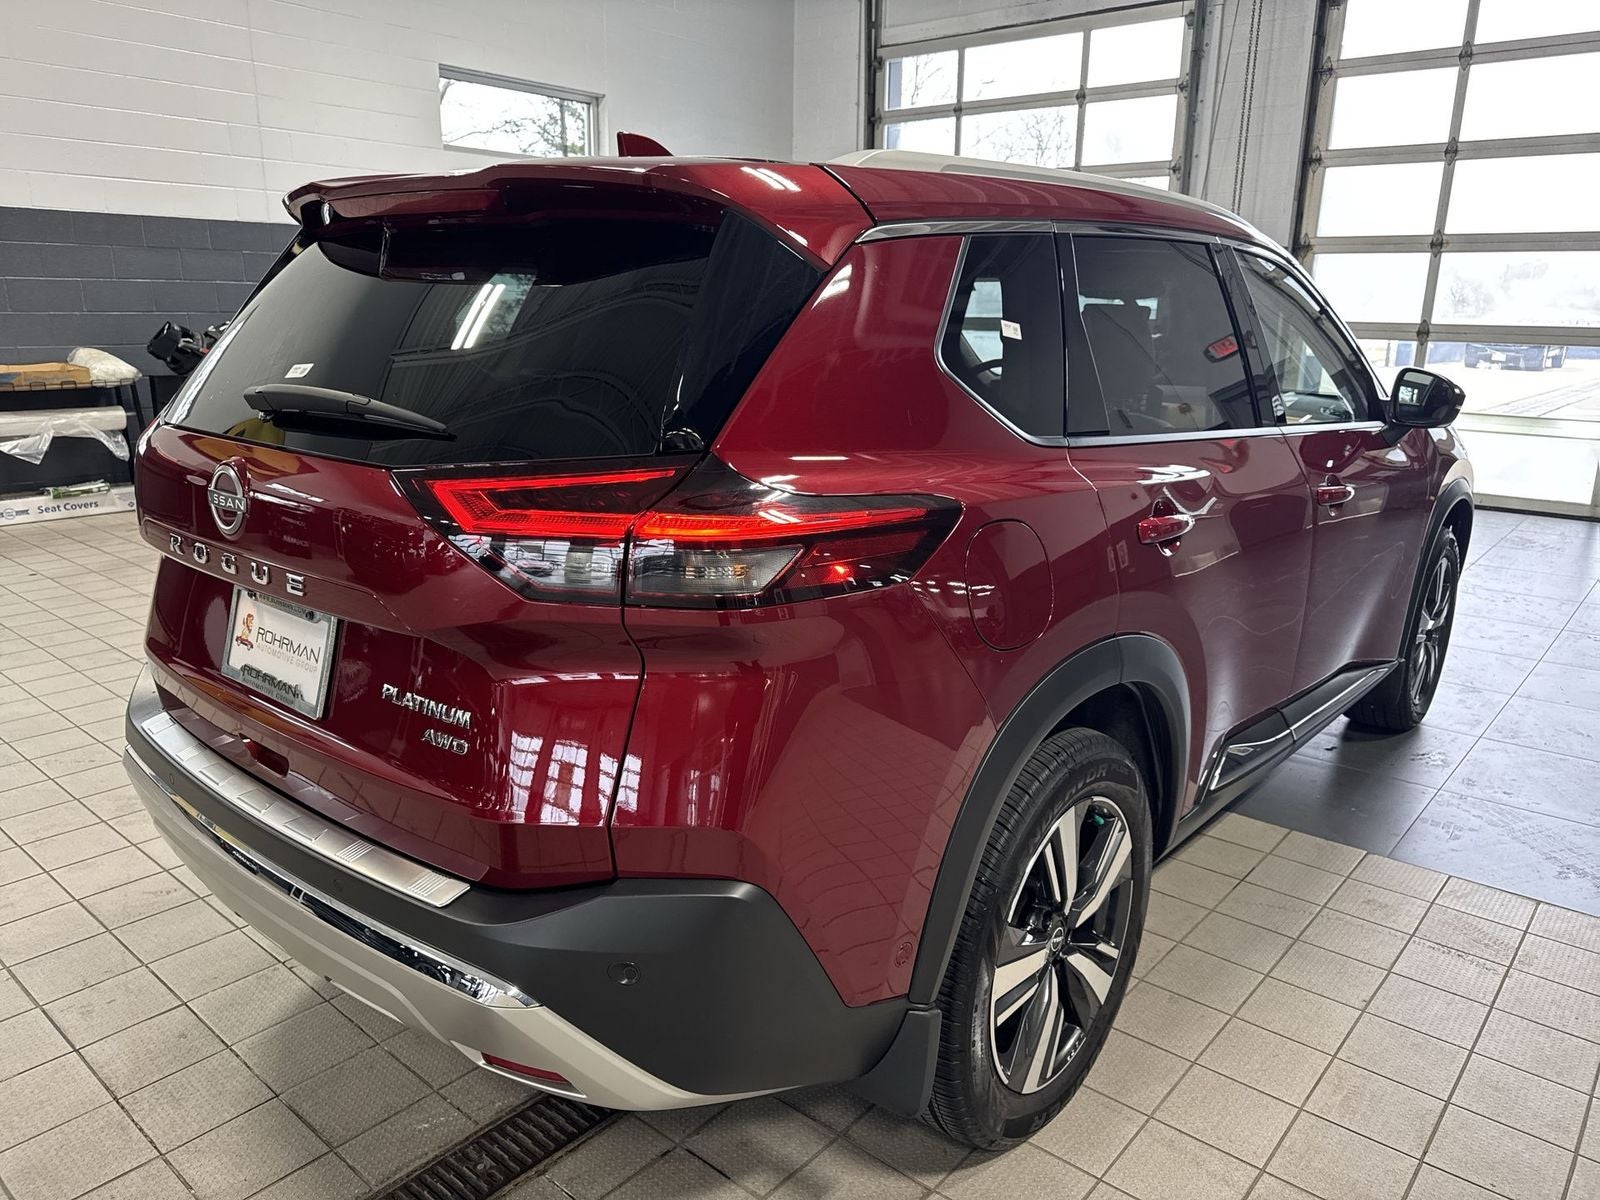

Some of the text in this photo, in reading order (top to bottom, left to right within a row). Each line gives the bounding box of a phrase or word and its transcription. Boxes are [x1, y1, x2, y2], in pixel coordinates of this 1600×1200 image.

[37, 499, 99, 515] Seat Covers
[212, 491, 245, 511] SSAN
[169, 532, 306, 597] ROGUE
[255, 626, 321, 664] ROHRMAN
[256, 643, 319, 673] AUTOMOTIVE GROUP
[242, 664, 299, 699] ROHRMAN
[381, 683, 472, 730] PLATINUM
[420, 728, 469, 755] AWD
